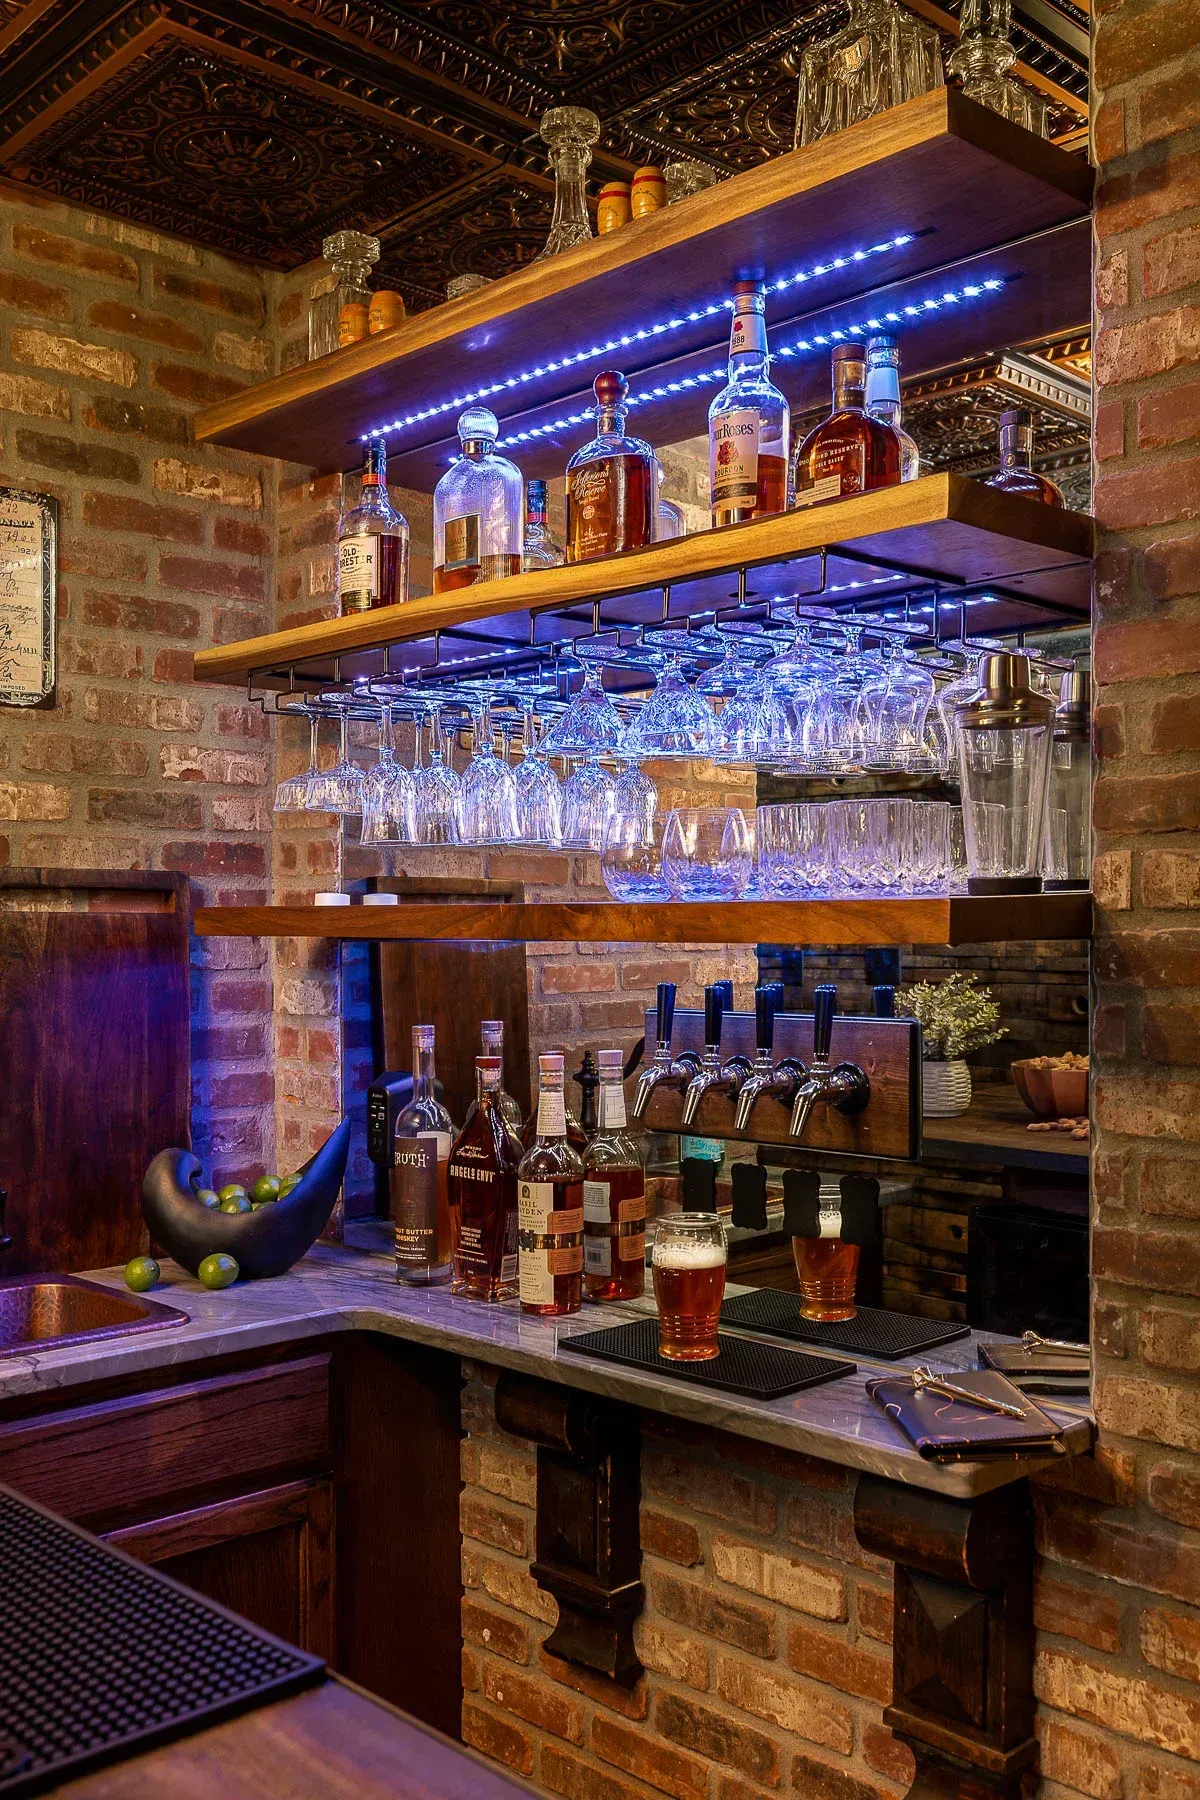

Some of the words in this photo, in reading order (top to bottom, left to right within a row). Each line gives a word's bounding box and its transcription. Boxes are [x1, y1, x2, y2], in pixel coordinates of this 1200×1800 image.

[342, 547, 356, 558] OLD
[519, 1200, 538, 1208] ASIL
[519, 1208, 543, 1216] AYDEN
